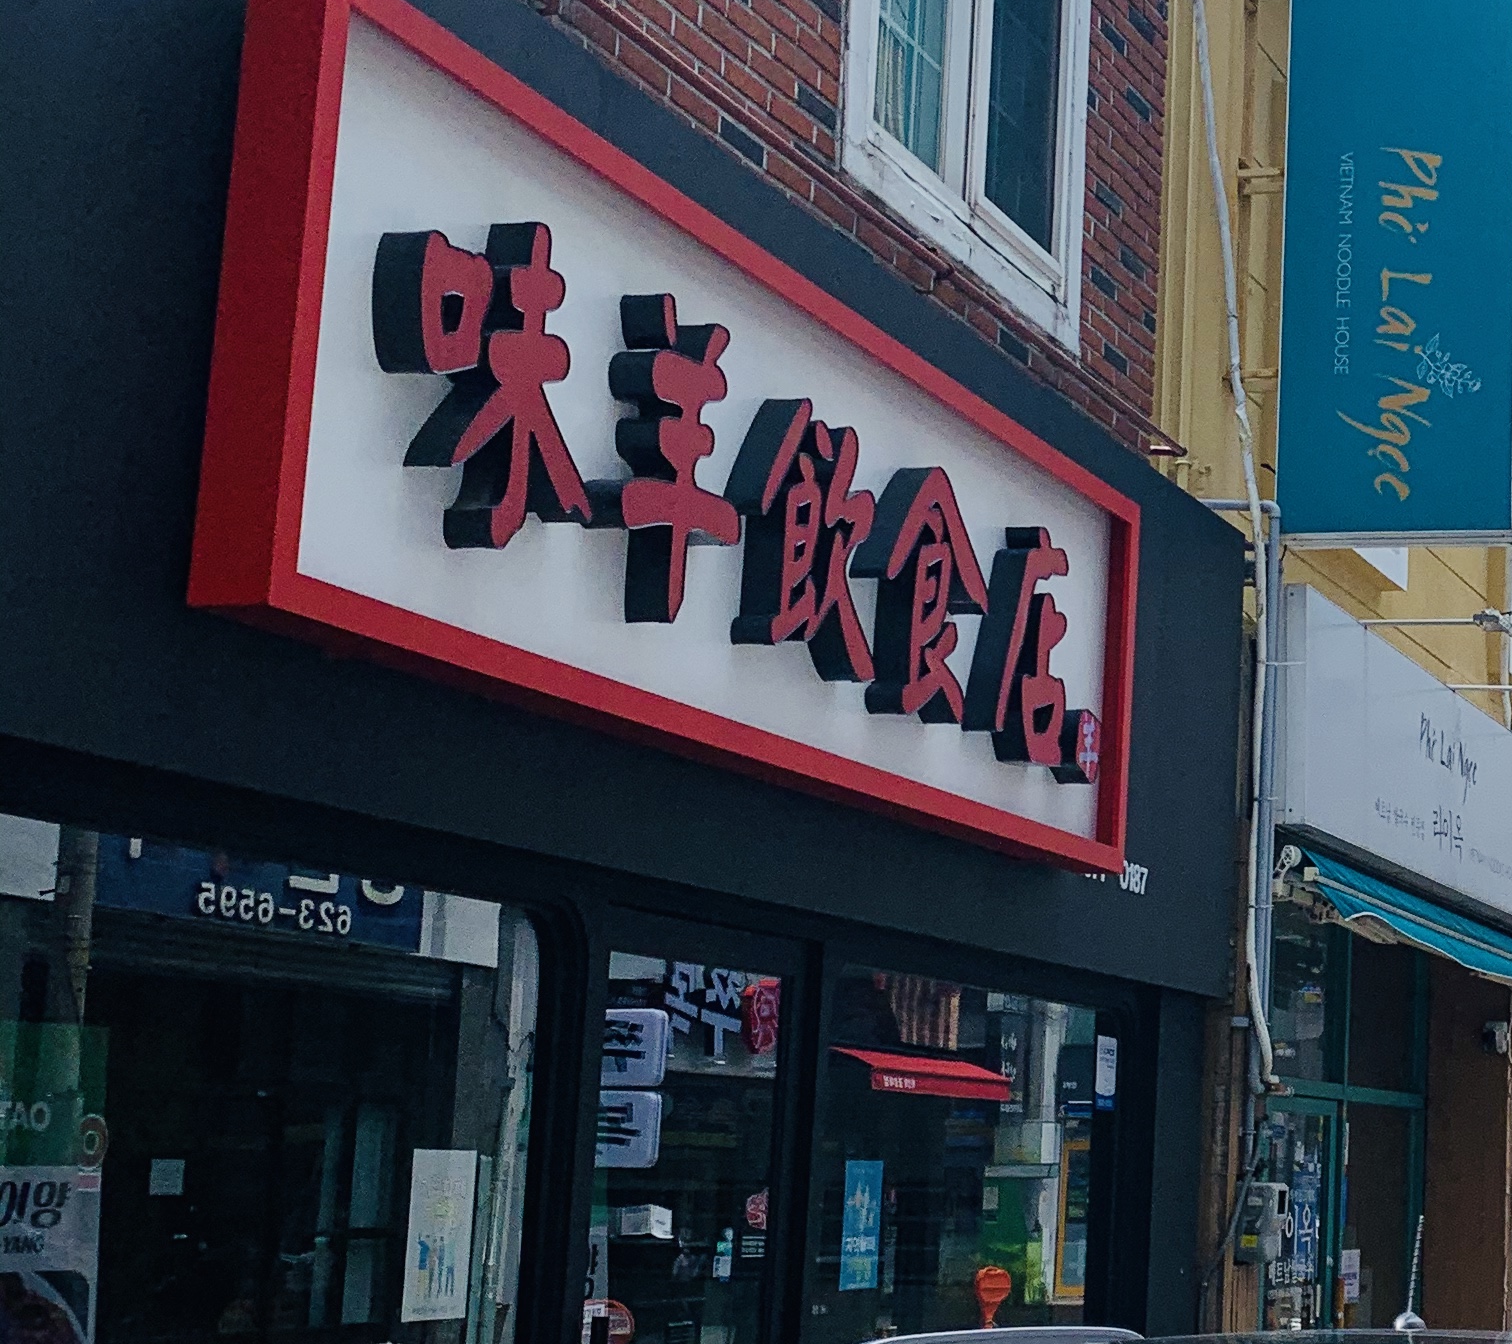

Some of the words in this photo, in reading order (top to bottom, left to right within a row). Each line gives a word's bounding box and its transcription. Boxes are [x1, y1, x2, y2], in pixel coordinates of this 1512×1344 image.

[1338, 151, 1355, 225] VIETNAM
[1336, 233, 1352, 308] NOODLE
[1334, 316, 1350, 376] HOUSE
